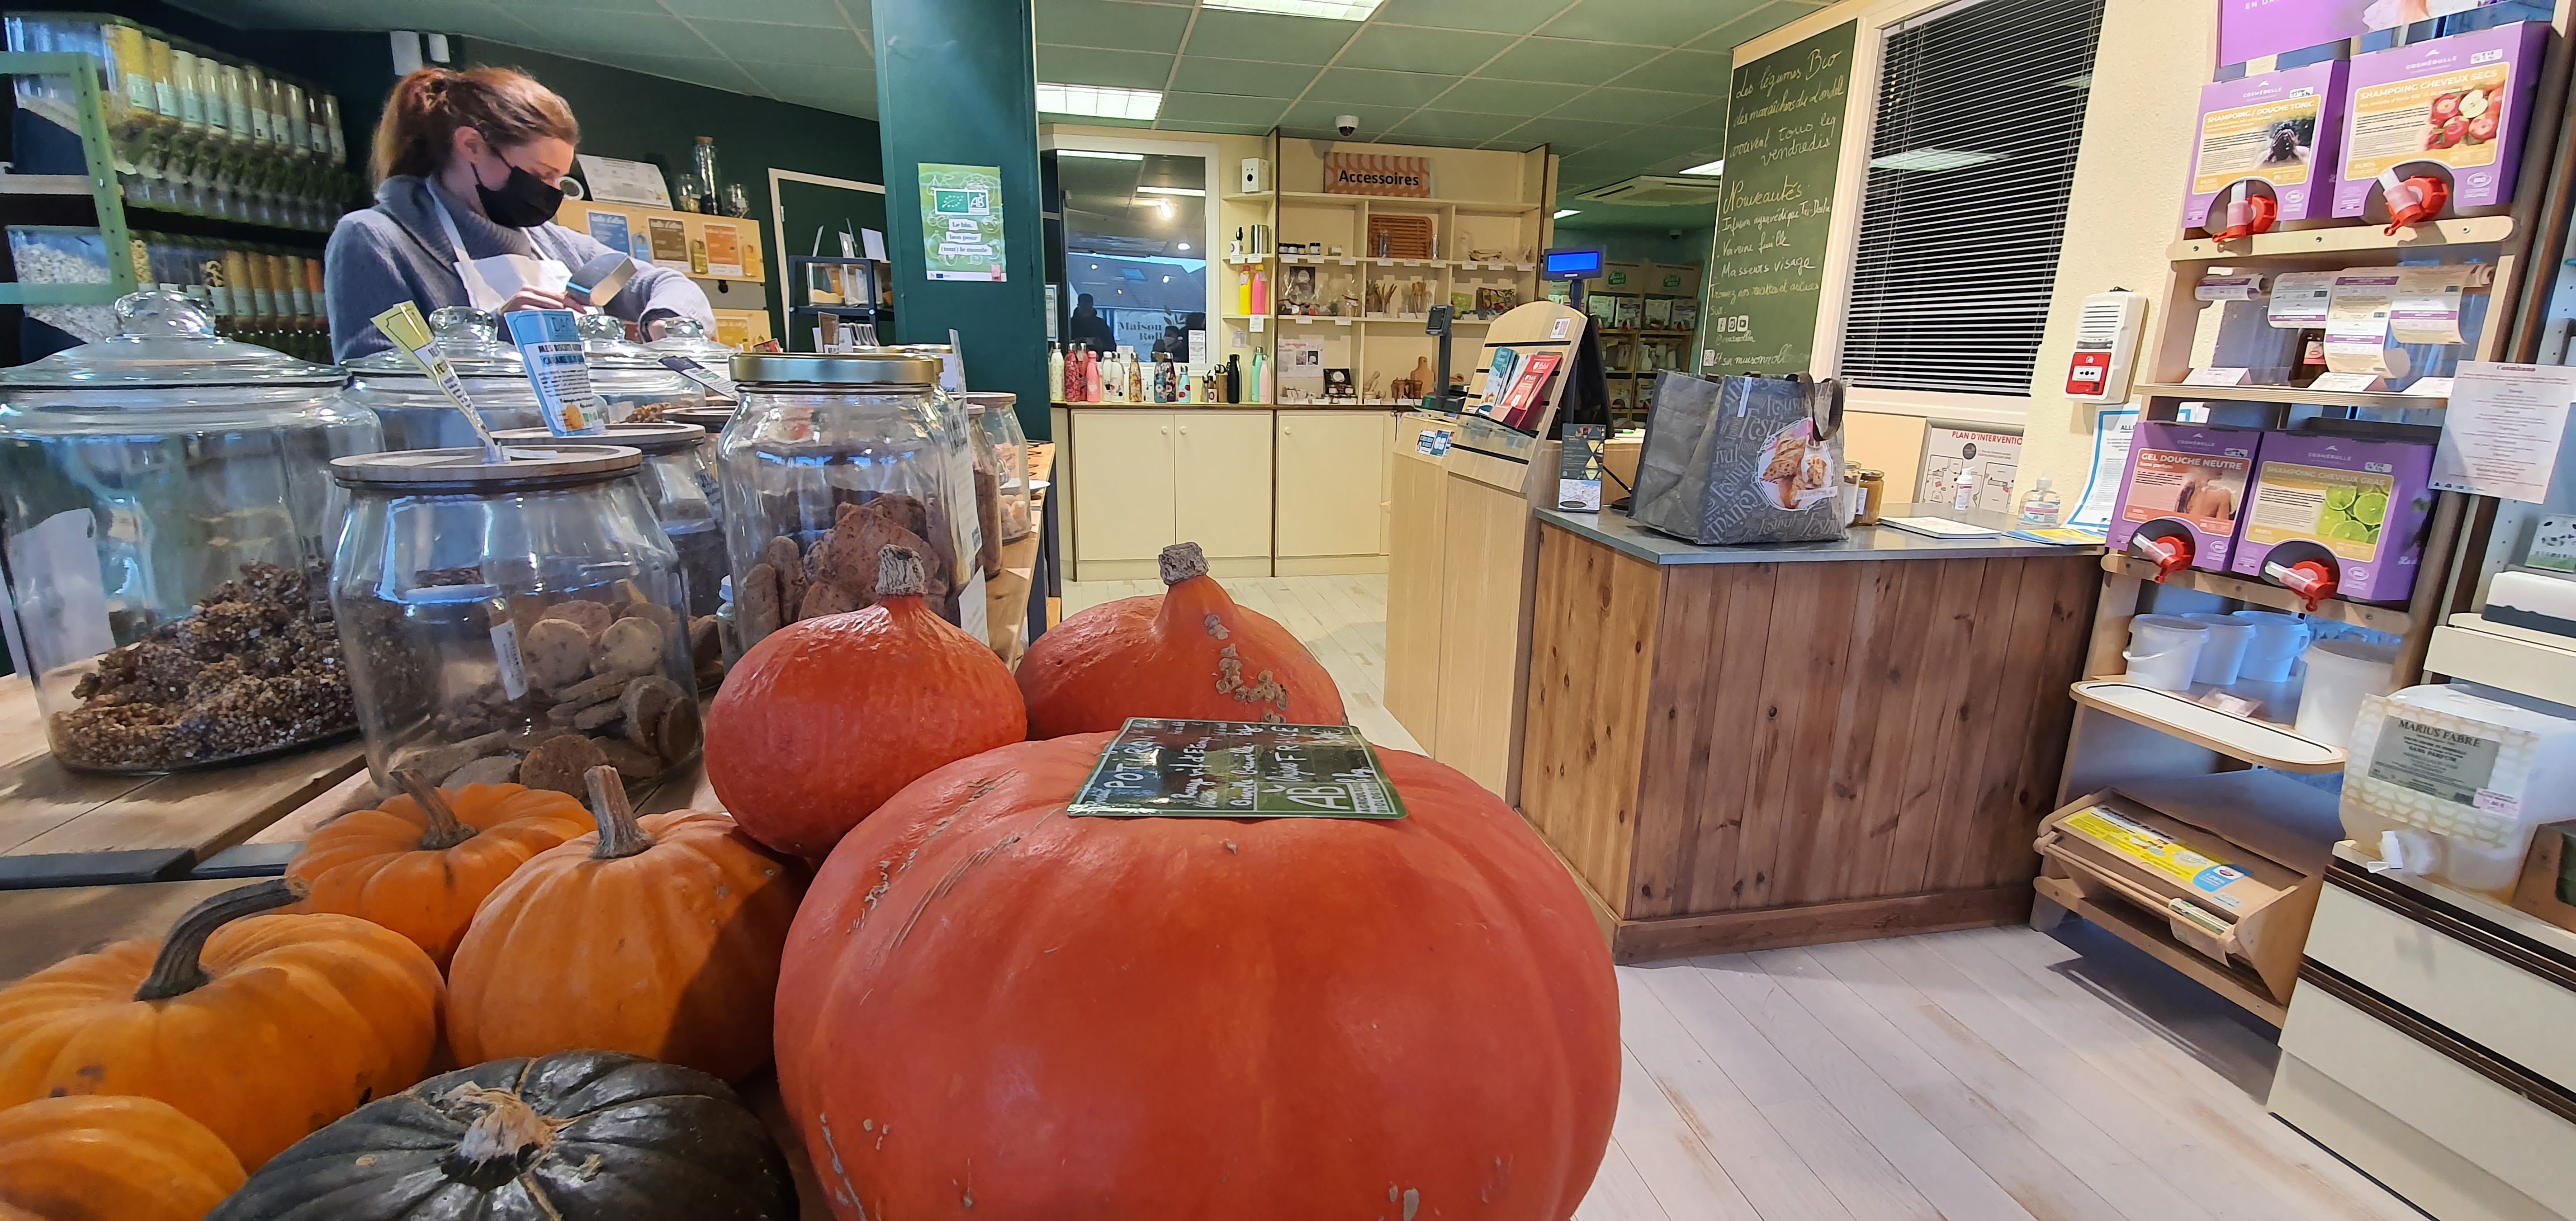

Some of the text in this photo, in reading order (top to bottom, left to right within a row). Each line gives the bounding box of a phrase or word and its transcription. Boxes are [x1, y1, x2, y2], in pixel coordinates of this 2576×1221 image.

[1736, 49, 1843, 98] Les légumes Bio
[2360, 70, 2498, 100] SHAMPOING CHEVEUX SECS
[2206, 111, 2251, 123] SHAMPOING
[2257, 105, 2289, 115] DOUCHE
[2290, 100, 2315, 110] TONIC
[1779, 124, 1813, 141] tous
[1761, 134, 1830, 166] vendredis
[1339, 169, 1419, 186] Accessoires
[1774, 257, 1816, 276] visage
[1119, 321, 1162, 331] Maison
[1952, 431, 1969, 439] PLAN
[2141, 453, 2243, 470] GEL DOUCHE NEUTRE
[2266, 466, 2317, 479] SHAMPOING
[2319, 472, 2359, 484] CHEVEUX
[2360, 477, 2385, 487] GRAS
[1271, 726, 1307, 761] FRANCE
[2399, 720, 2441, 737] MARIUS
[2442, 731, 2481, 747] FABRE
[1286, 785, 1351, 810] AB
